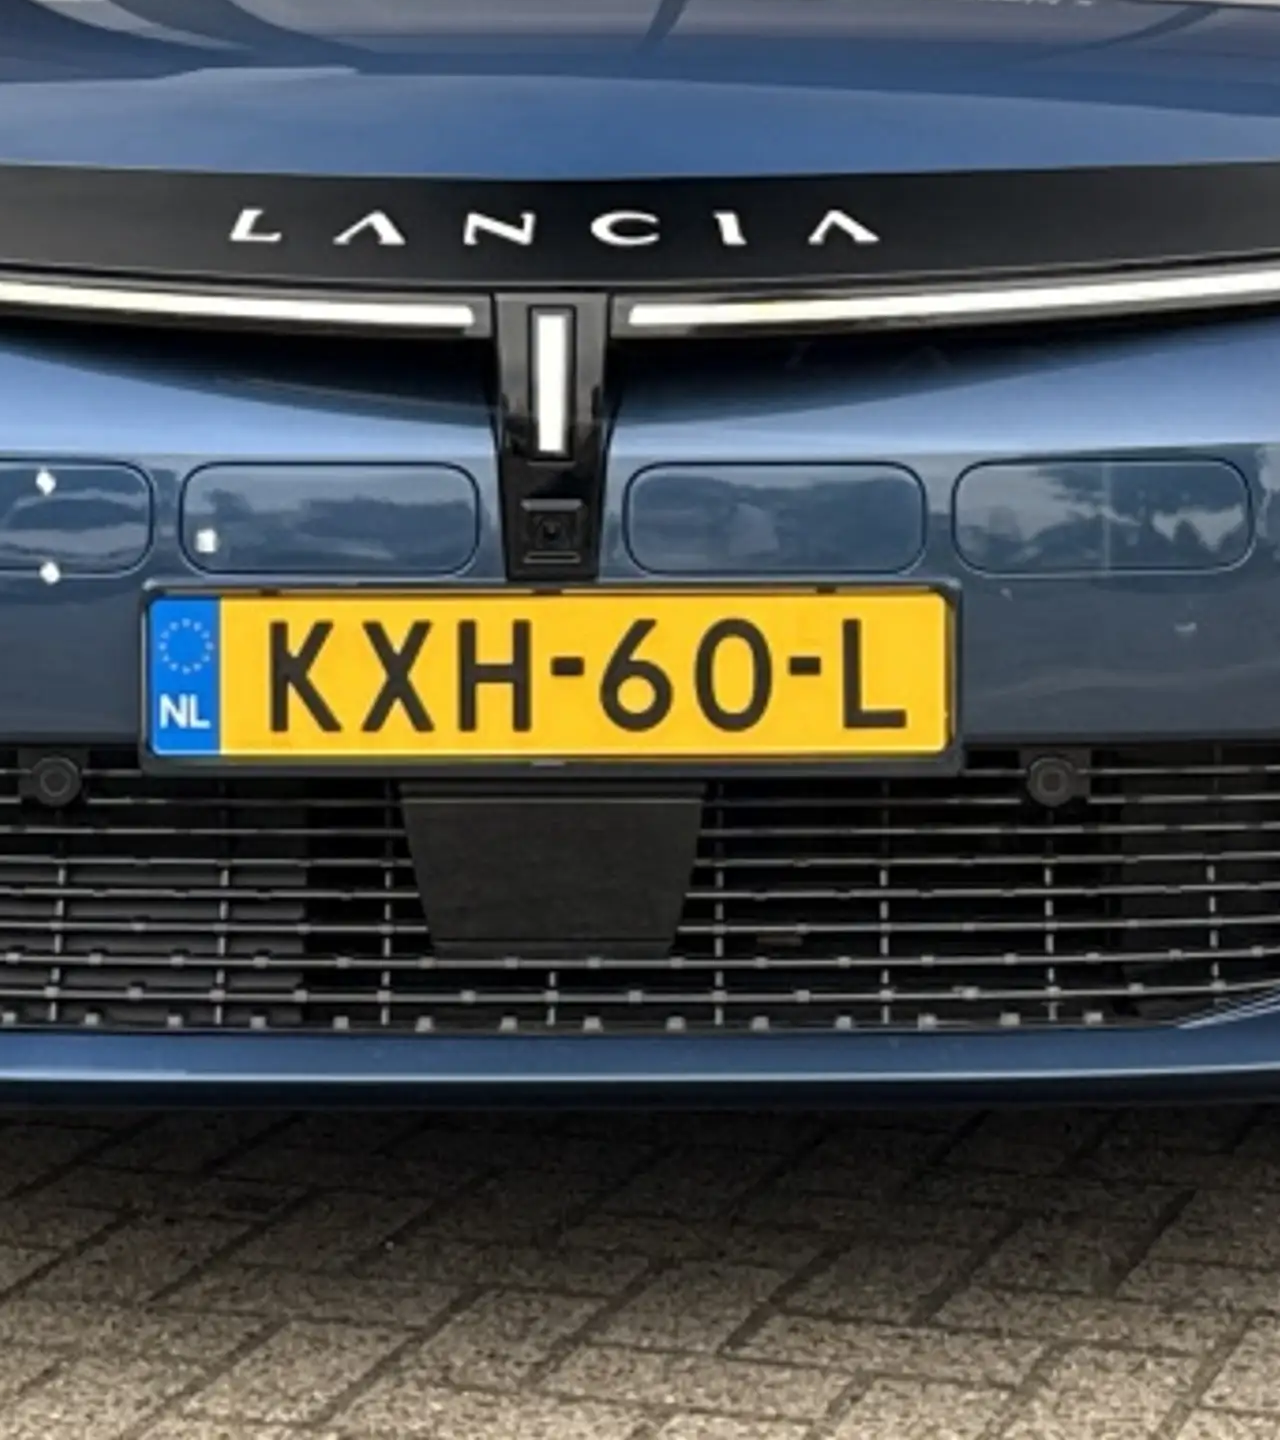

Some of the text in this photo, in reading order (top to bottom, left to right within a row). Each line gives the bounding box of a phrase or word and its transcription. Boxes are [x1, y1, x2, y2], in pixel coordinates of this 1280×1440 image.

[230, 208, 880, 246] LANCIA
[268, 617, 908, 733] KXH-60-L
[159, 693, 211, 729] NL
